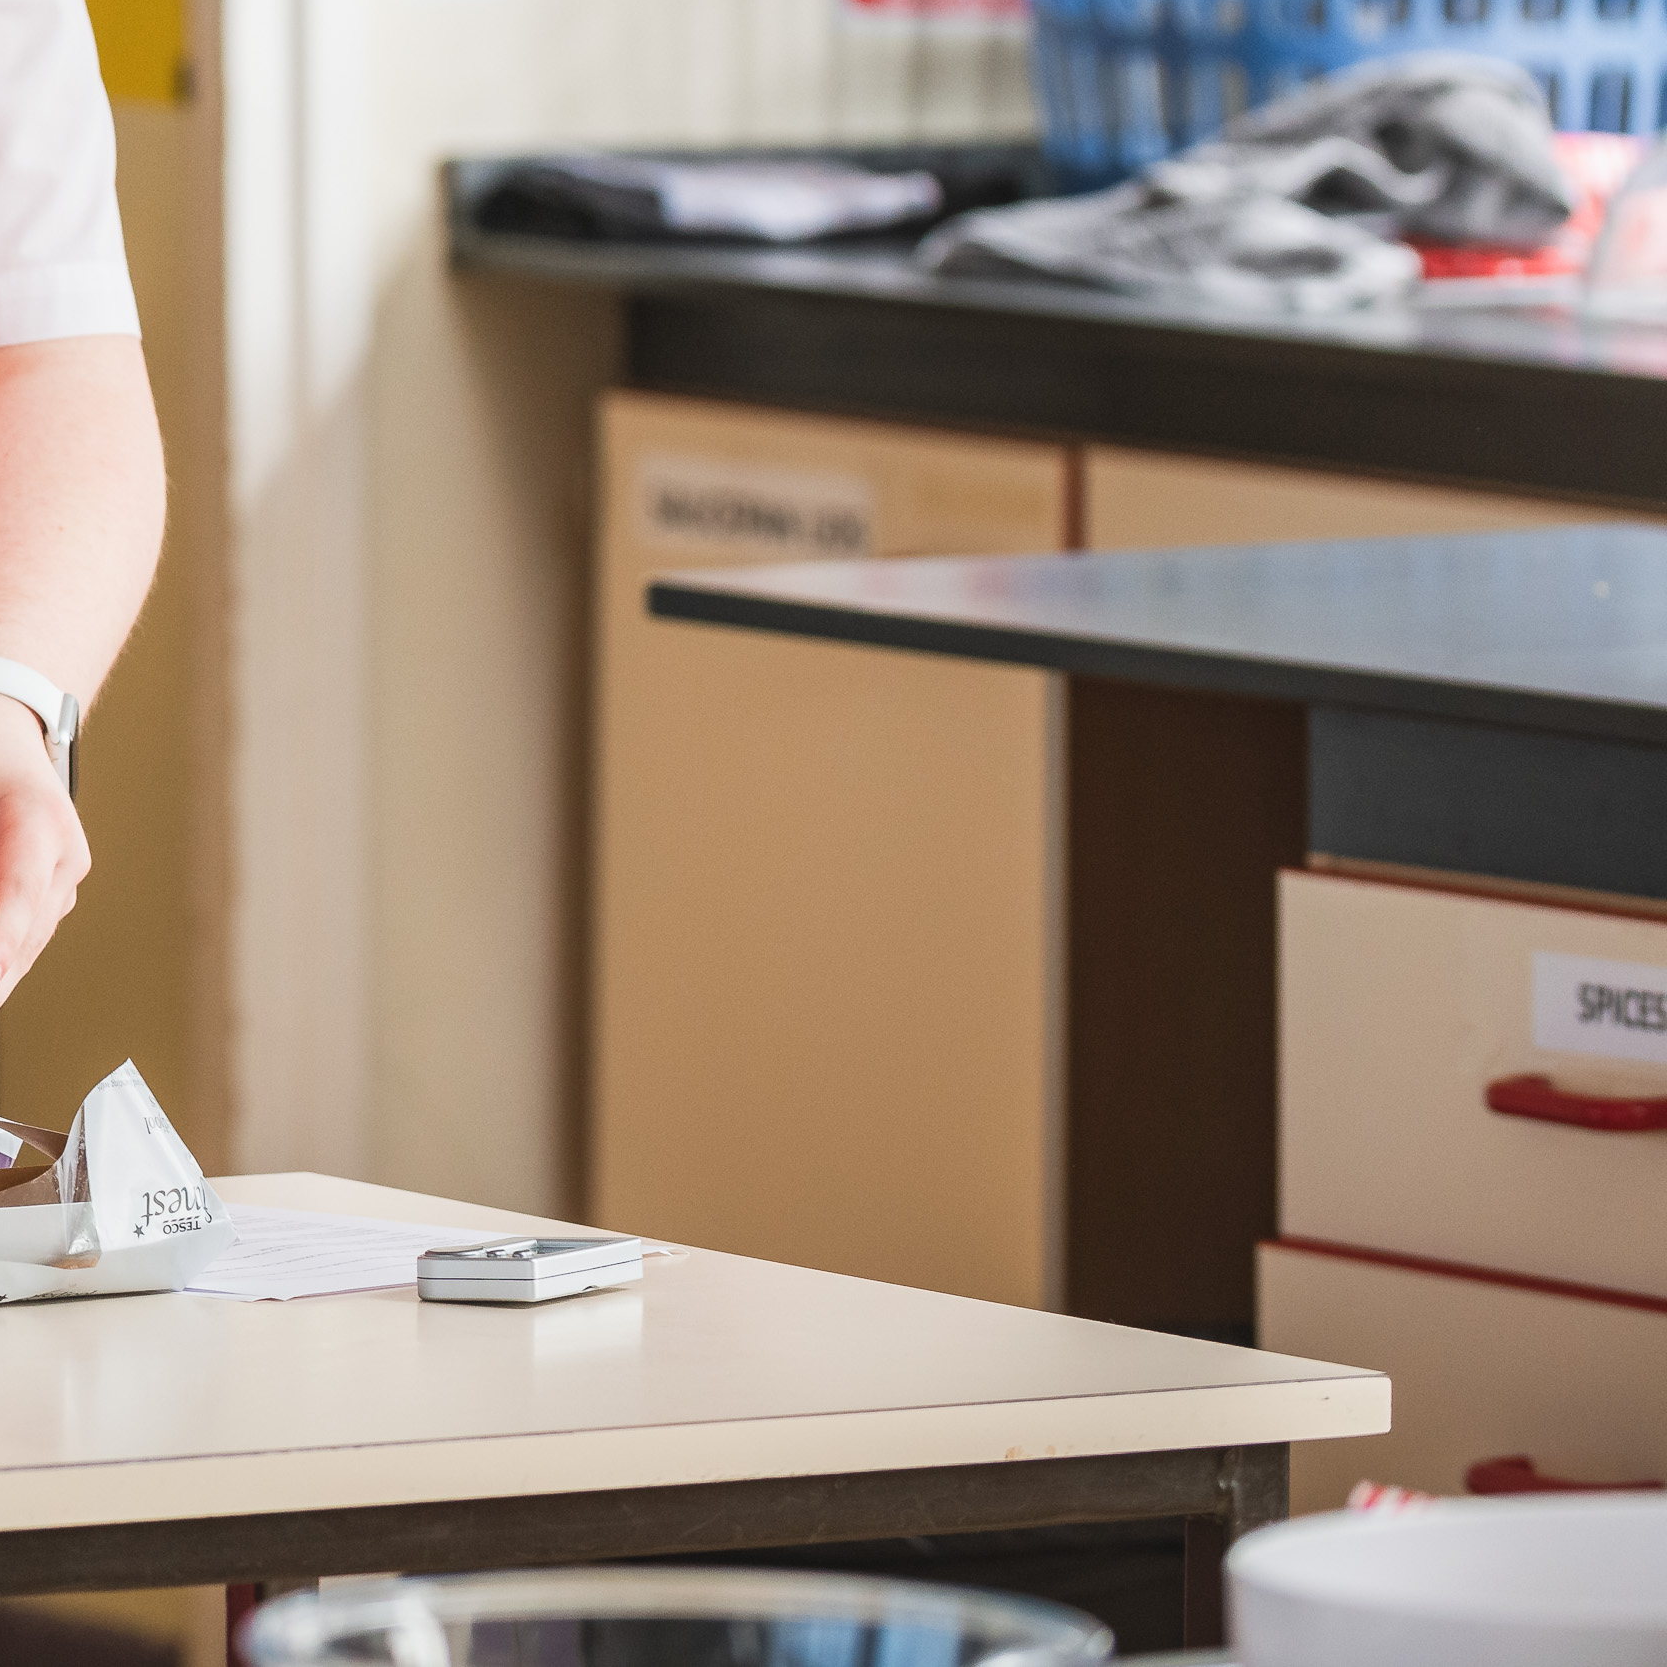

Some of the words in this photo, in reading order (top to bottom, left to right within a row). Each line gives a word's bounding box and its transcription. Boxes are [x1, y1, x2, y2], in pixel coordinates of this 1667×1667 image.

[1577, 983, 1667, 1032] SPICES
[141, 1176, 213, 1227] finest
[163, 1220, 202, 1235] TESCO
